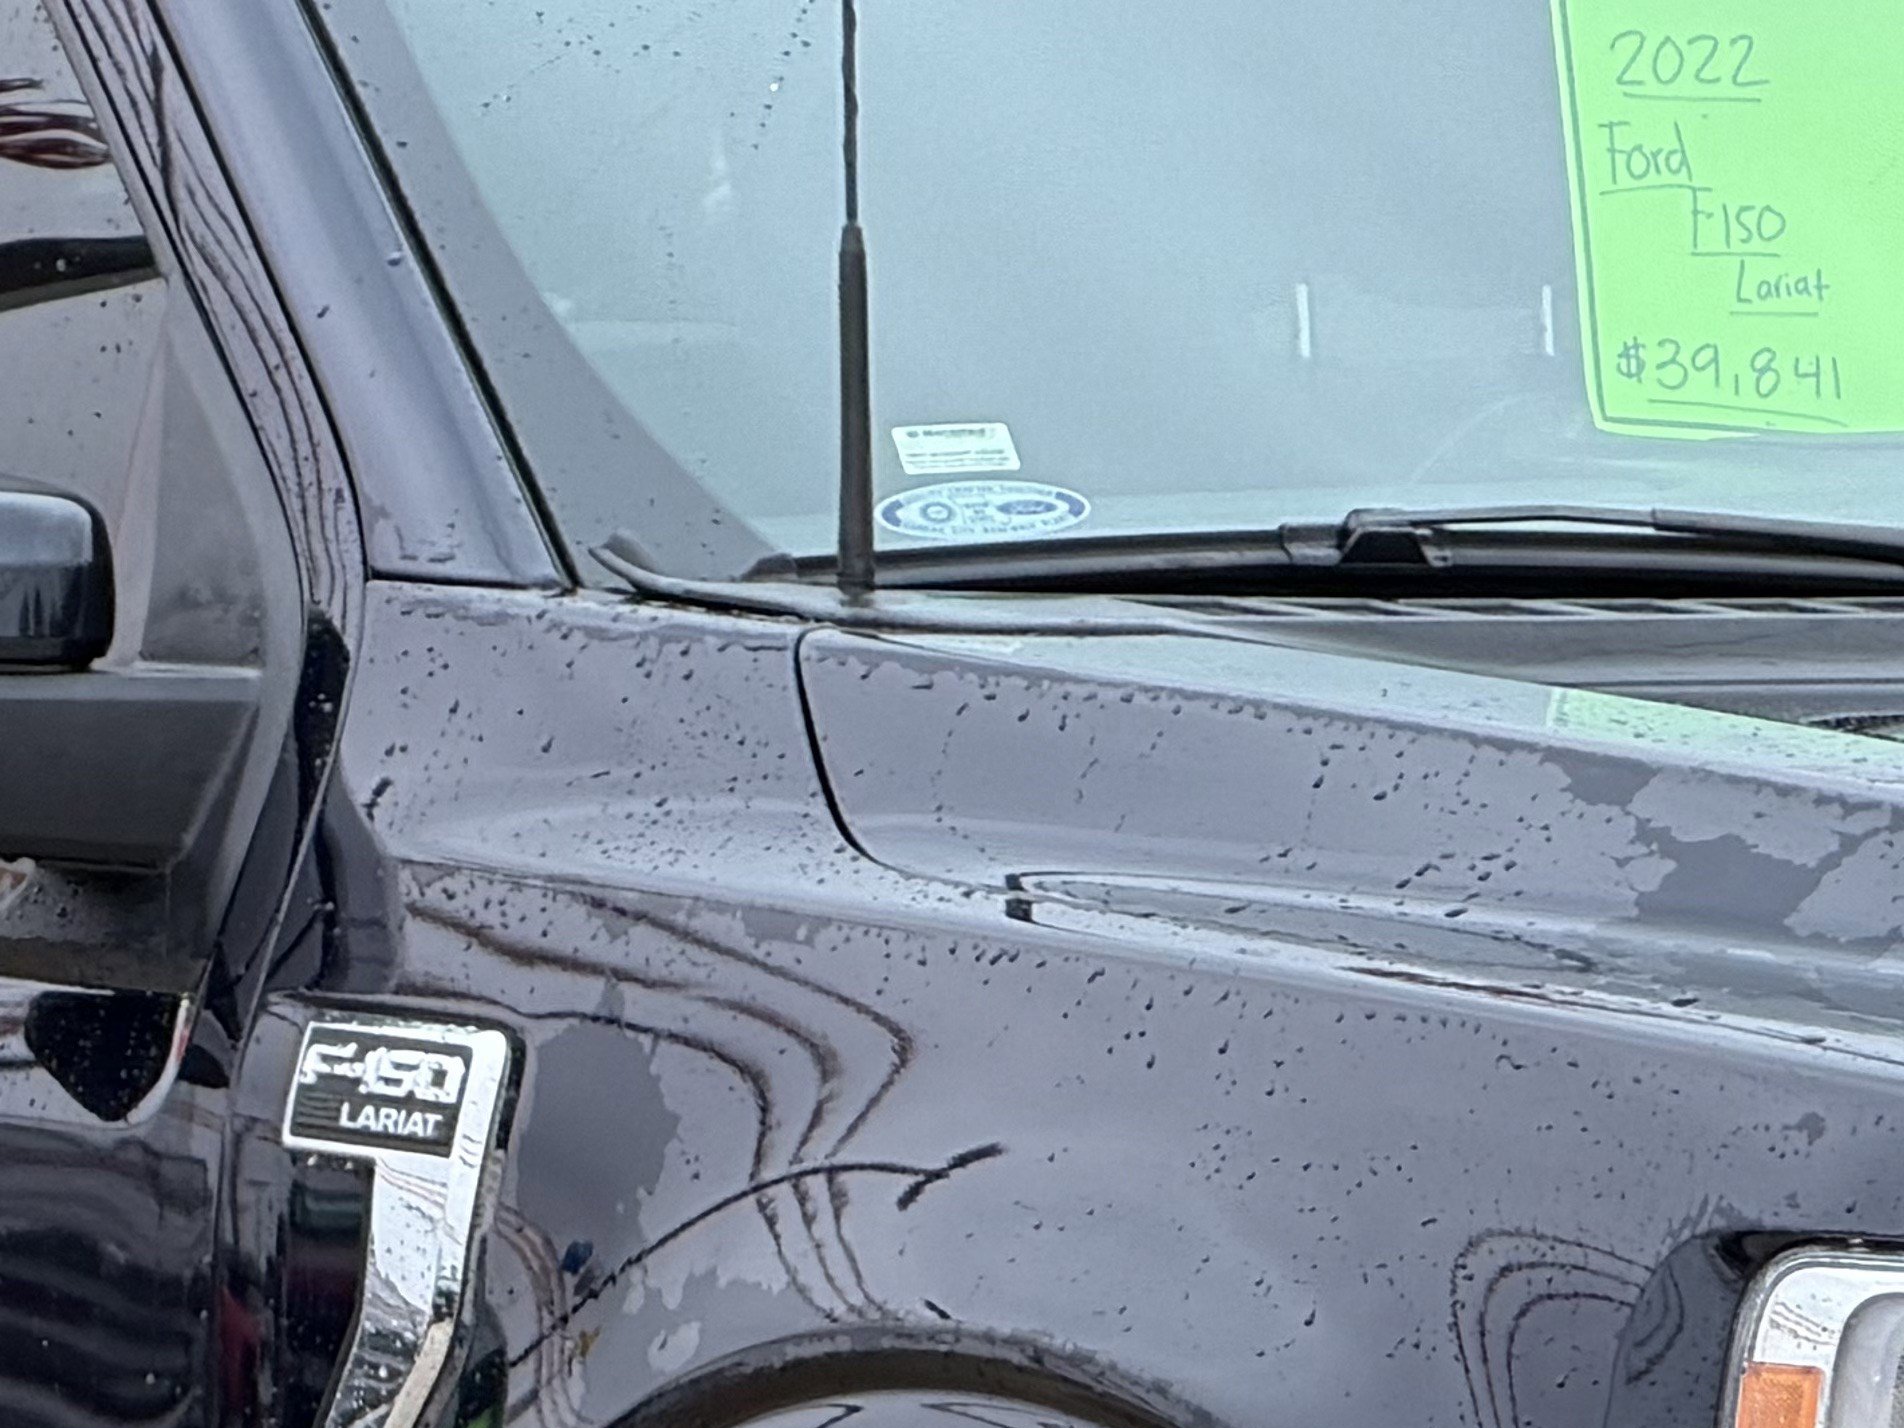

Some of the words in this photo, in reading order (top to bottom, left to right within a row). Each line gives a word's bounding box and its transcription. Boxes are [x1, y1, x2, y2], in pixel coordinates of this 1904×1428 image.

[1609, 29, 1771, 87] 2022
[1598, 119, 1693, 185] Ford
[1689, 186, 1787, 250] F150
[1736, 258, 1831, 304] Lariat
[1616, 336, 1842, 400] $39,841
[300, 1042, 466, 1104] F-150
[338, 1101, 443, 1138] LARIAT
